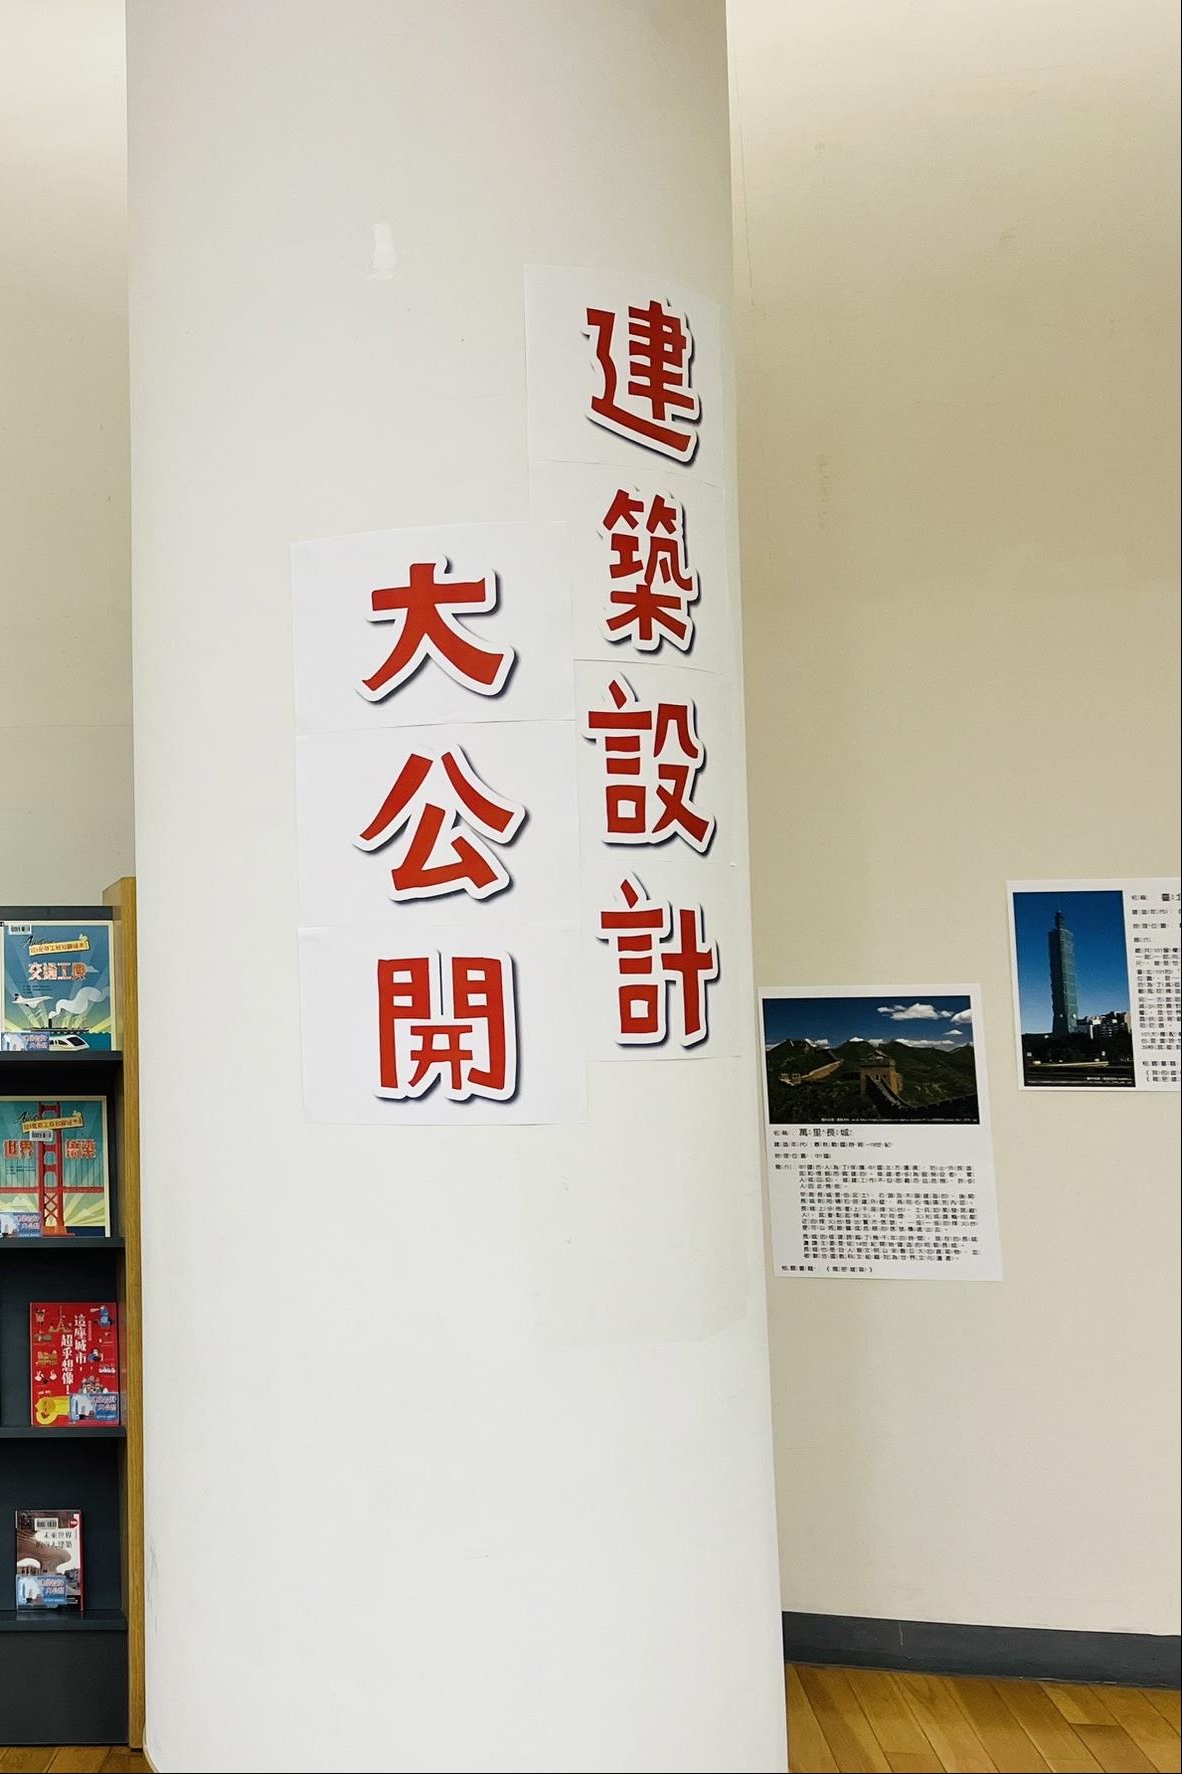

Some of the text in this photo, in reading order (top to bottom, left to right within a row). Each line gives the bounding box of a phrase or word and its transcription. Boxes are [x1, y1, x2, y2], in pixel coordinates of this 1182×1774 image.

[356, 560, 518, 1094] 大公開
[582, 298, 718, 1044] 建築設計
